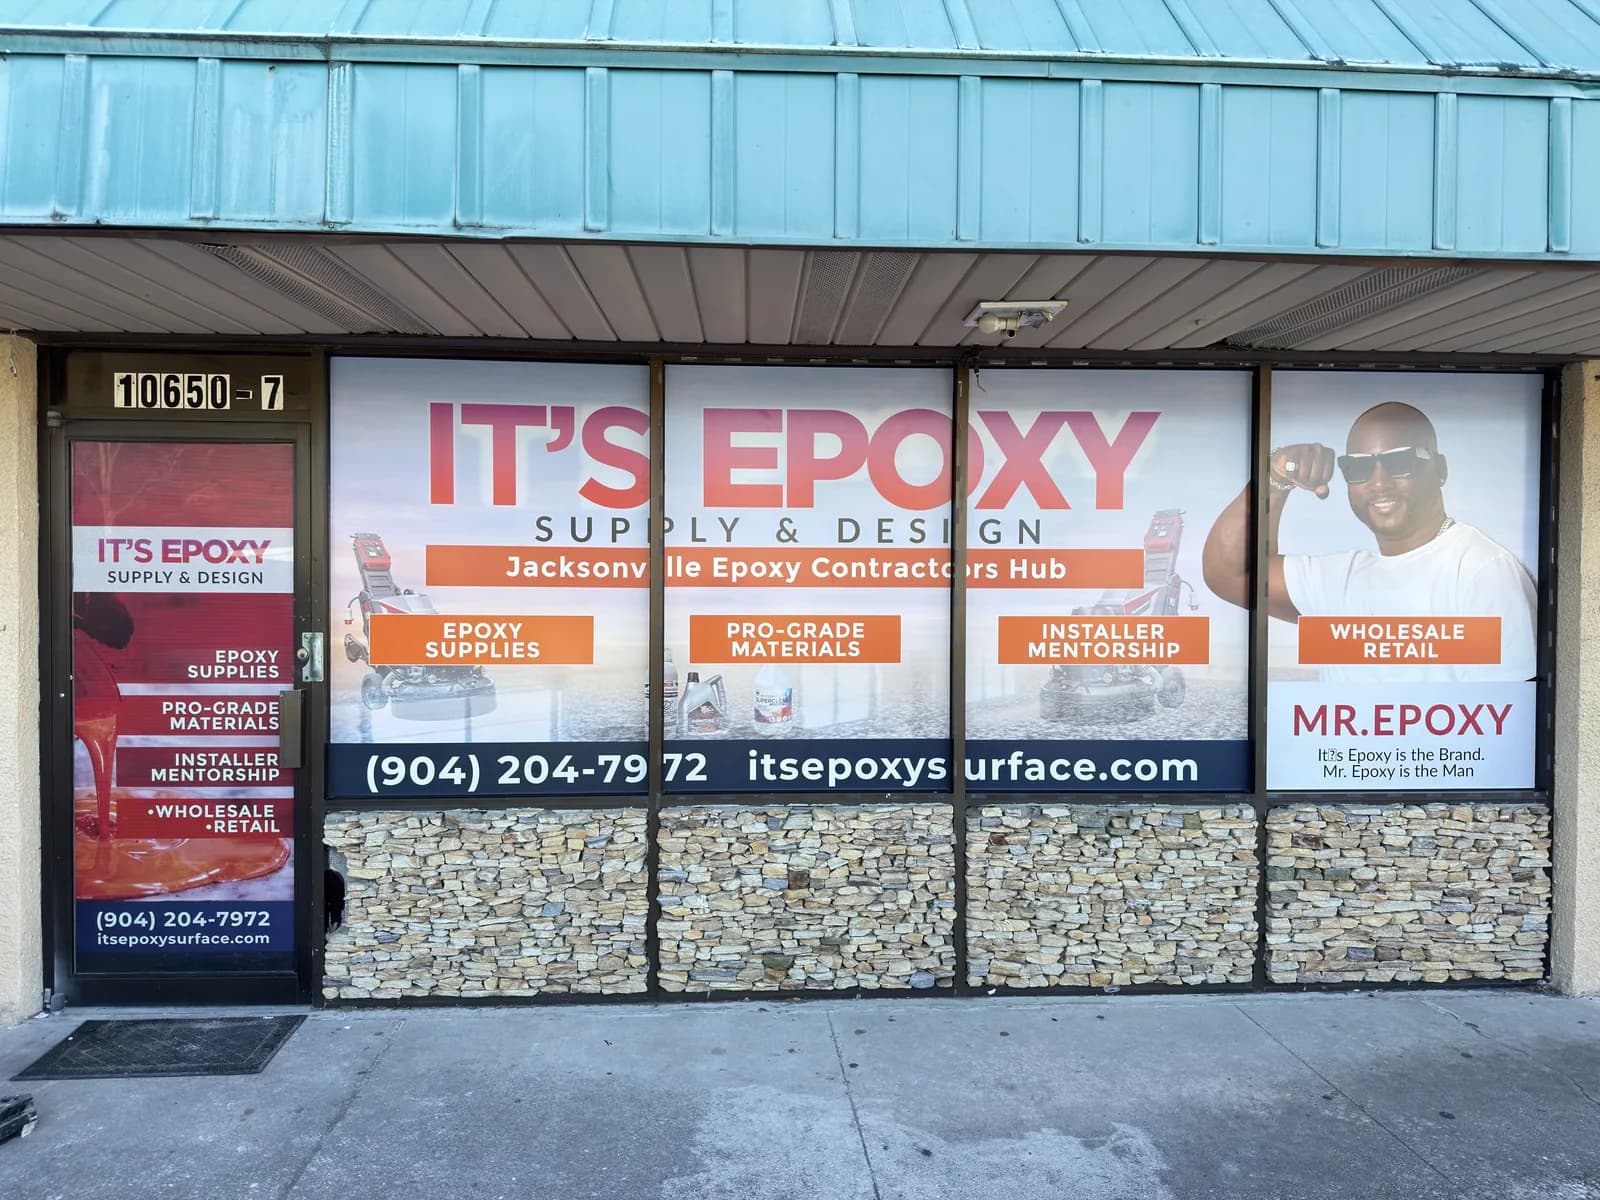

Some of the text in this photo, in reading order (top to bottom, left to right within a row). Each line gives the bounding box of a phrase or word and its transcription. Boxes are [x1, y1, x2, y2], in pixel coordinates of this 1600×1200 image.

[703, 408, 1161, 511] EPOXY
[535, 516, 1041, 545] SUPPLY & DESIGN
[161, 539, 271, 564] EPOXY
[107, 571, 263, 584] SUPPLY & DESIGN
[506, 555, 1067, 585] Jacksonvlle Epoxy Contractors Hub
[443, 622, 523, 640] EPOXY
[727, 622, 865, 639] PRO-GRADE
[1042, 623, 1165, 640] INSTALLER
[1330, 623, 1465, 640] WHOLESALE
[215, 650, 279, 664] EPOXY
[425, 641, 540, 659] SUPPLIES
[732, 640, 861, 658] MATERIALS
[1028, 641, 1181, 658] MENTORSHIP
[1363, 642, 1439, 658] RETAIL
[187, 665, 280, 679] SUPPLIES
[162, 701, 280, 715] PRO-GRADE
[170, 716, 280, 730] MATERIALS
[1293, 703, 1513, 737] MR.EPOXY
[175, 753, 279, 766] INSTALLER
[1348, 748, 1392, 766] Epoxy
[1396, 748, 1407, 762] is
[1411, 748, 1435, 762] the
[1439, 747, 1485, 761] Brand.
[151, 768, 280, 782] MENTORSHIP
[366, 749, 1199, 793] (904) 204-7972 itsepoxysurface.com
[1323, 764, 1474, 780] Mr. Epoxy is the Man
[96, 911, 270, 929] (904) 204-7972
[97, 933, 270, 948] itsepoxysurface.com
